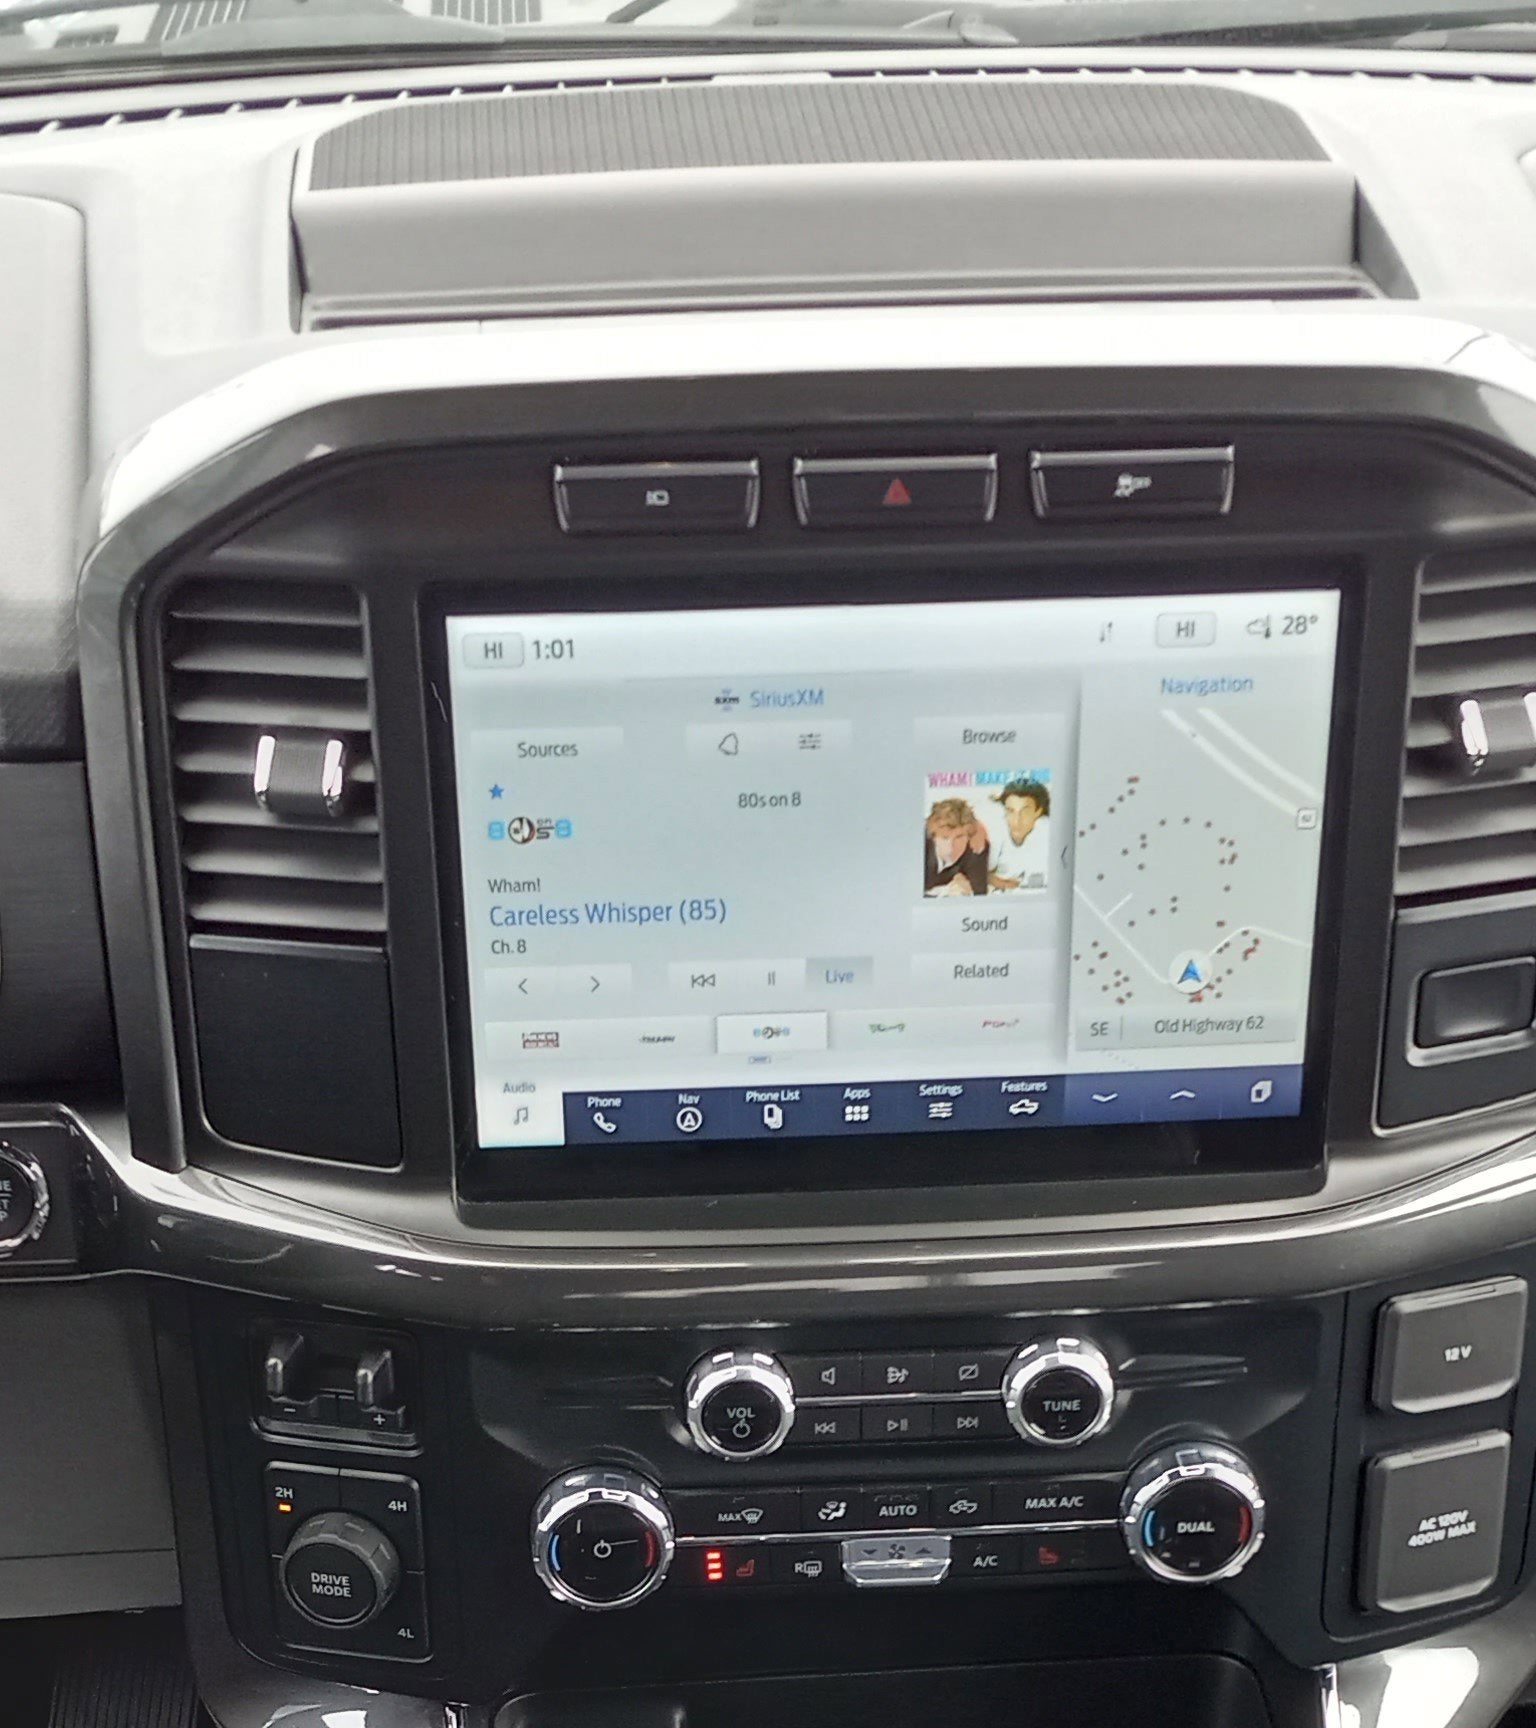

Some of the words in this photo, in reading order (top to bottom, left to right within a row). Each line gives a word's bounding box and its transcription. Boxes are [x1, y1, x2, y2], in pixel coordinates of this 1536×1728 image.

[1175, 621, 1196, 639] HI
[483, 641, 505, 660] HI
[531, 638, 577, 661] 1:01
[1160, 674, 1255, 697] Navigation
[750, 688, 825, 709] SiriusXM
[961, 727, 1018, 746] Browse
[516, 740, 579, 759] Sources
[737, 792, 767, 809] 80s
[768, 794, 789, 808] on
[790, 790, 802, 808] 8
[487, 877, 542, 895] Wham!
[489, 903, 580, 928] Careless
[584, 901, 674, 927] Whisper
[678, 897, 728, 925] (85)
[960, 915, 1009, 934] Sound
[490, 937, 515, 956] Ch.
[516, 938, 528, 956] 8
[824, 967, 855, 986] Live
[953, 962, 1010, 981] Related
[1089, 1021, 1110, 1038] SE
[1153, 1018, 1179, 1035] Old
[1182, 1016, 1243, 1036] Highway
[1245, 1015, 1265, 1031] 62
[502, 1080, 537, 1095] Audio
[842, 1086, 872, 1101] Apps
[918, 1082, 964, 1098] Settings
[1000, 1080, 1049, 1095] Features
[586, 1095, 623, 1110] Phone
[677, 1092, 701, 1106] Nav
[745, 1089, 779, 1104] Phone
[779, 1089, 801, 1103] List
[725, 1405, 756, 1420] VOL
[1042, 1399, 1082, 1413] TUNE
[274, 1486, 294, 1499] 2H
[387, 1499, 409, 1513] 4H
[878, 1504, 918, 1518] AUTO
[1024, 1497, 1058, 1511] MAX
[1058, 1494, 1085, 1510] A/C
[717, 1511, 742, 1524] MAX
[1418, 1515, 1438, 1532] AC
[1176, 1520, 1216, 1535] DUAL
[1407, 1529, 1447, 1548] 400W
[1446, 1520, 1478, 1540] MAX
[972, 1555, 999, 1569] A/C
[310, 1571, 351, 1588] DRIVE
[311, 1583, 353, 1599] MODE
[397, 1627, 416, 1640] 4L
